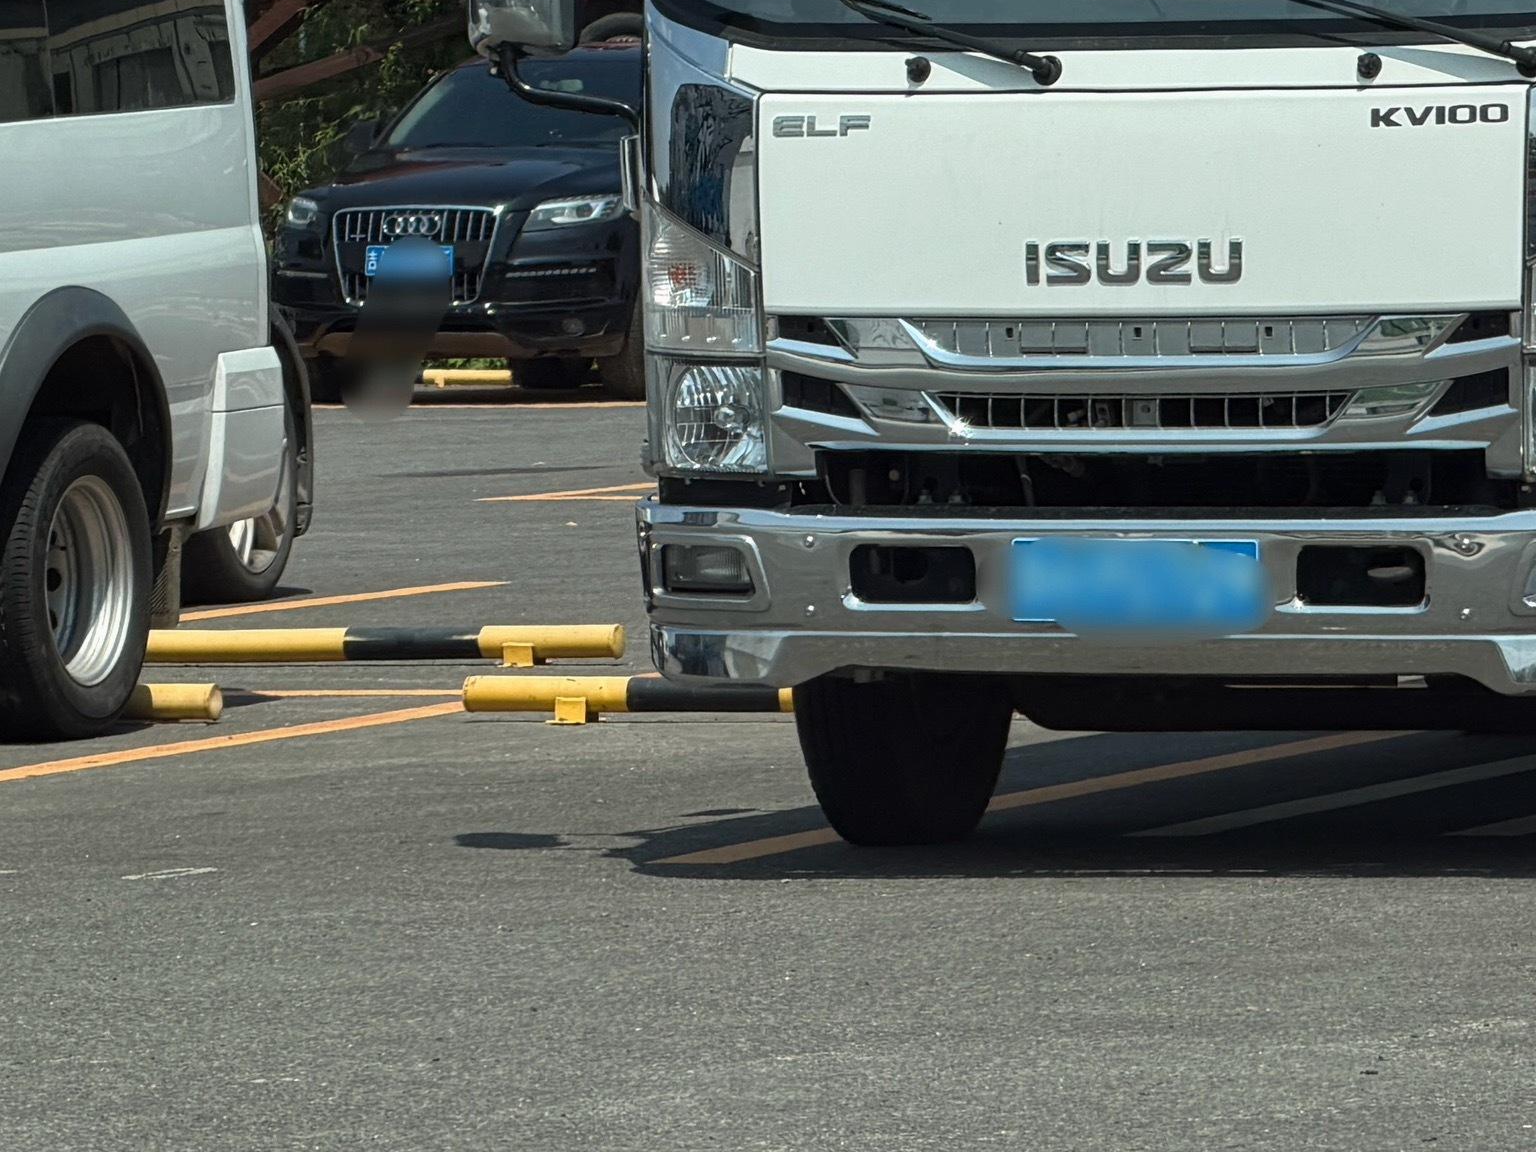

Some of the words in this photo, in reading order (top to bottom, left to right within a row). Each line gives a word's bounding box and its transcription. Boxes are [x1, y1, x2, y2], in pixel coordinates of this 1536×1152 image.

[772, 115, 871, 138] ELF
[1370, 103, 1509, 128] KV100
[1025, 237, 1244, 287] ISUZU
